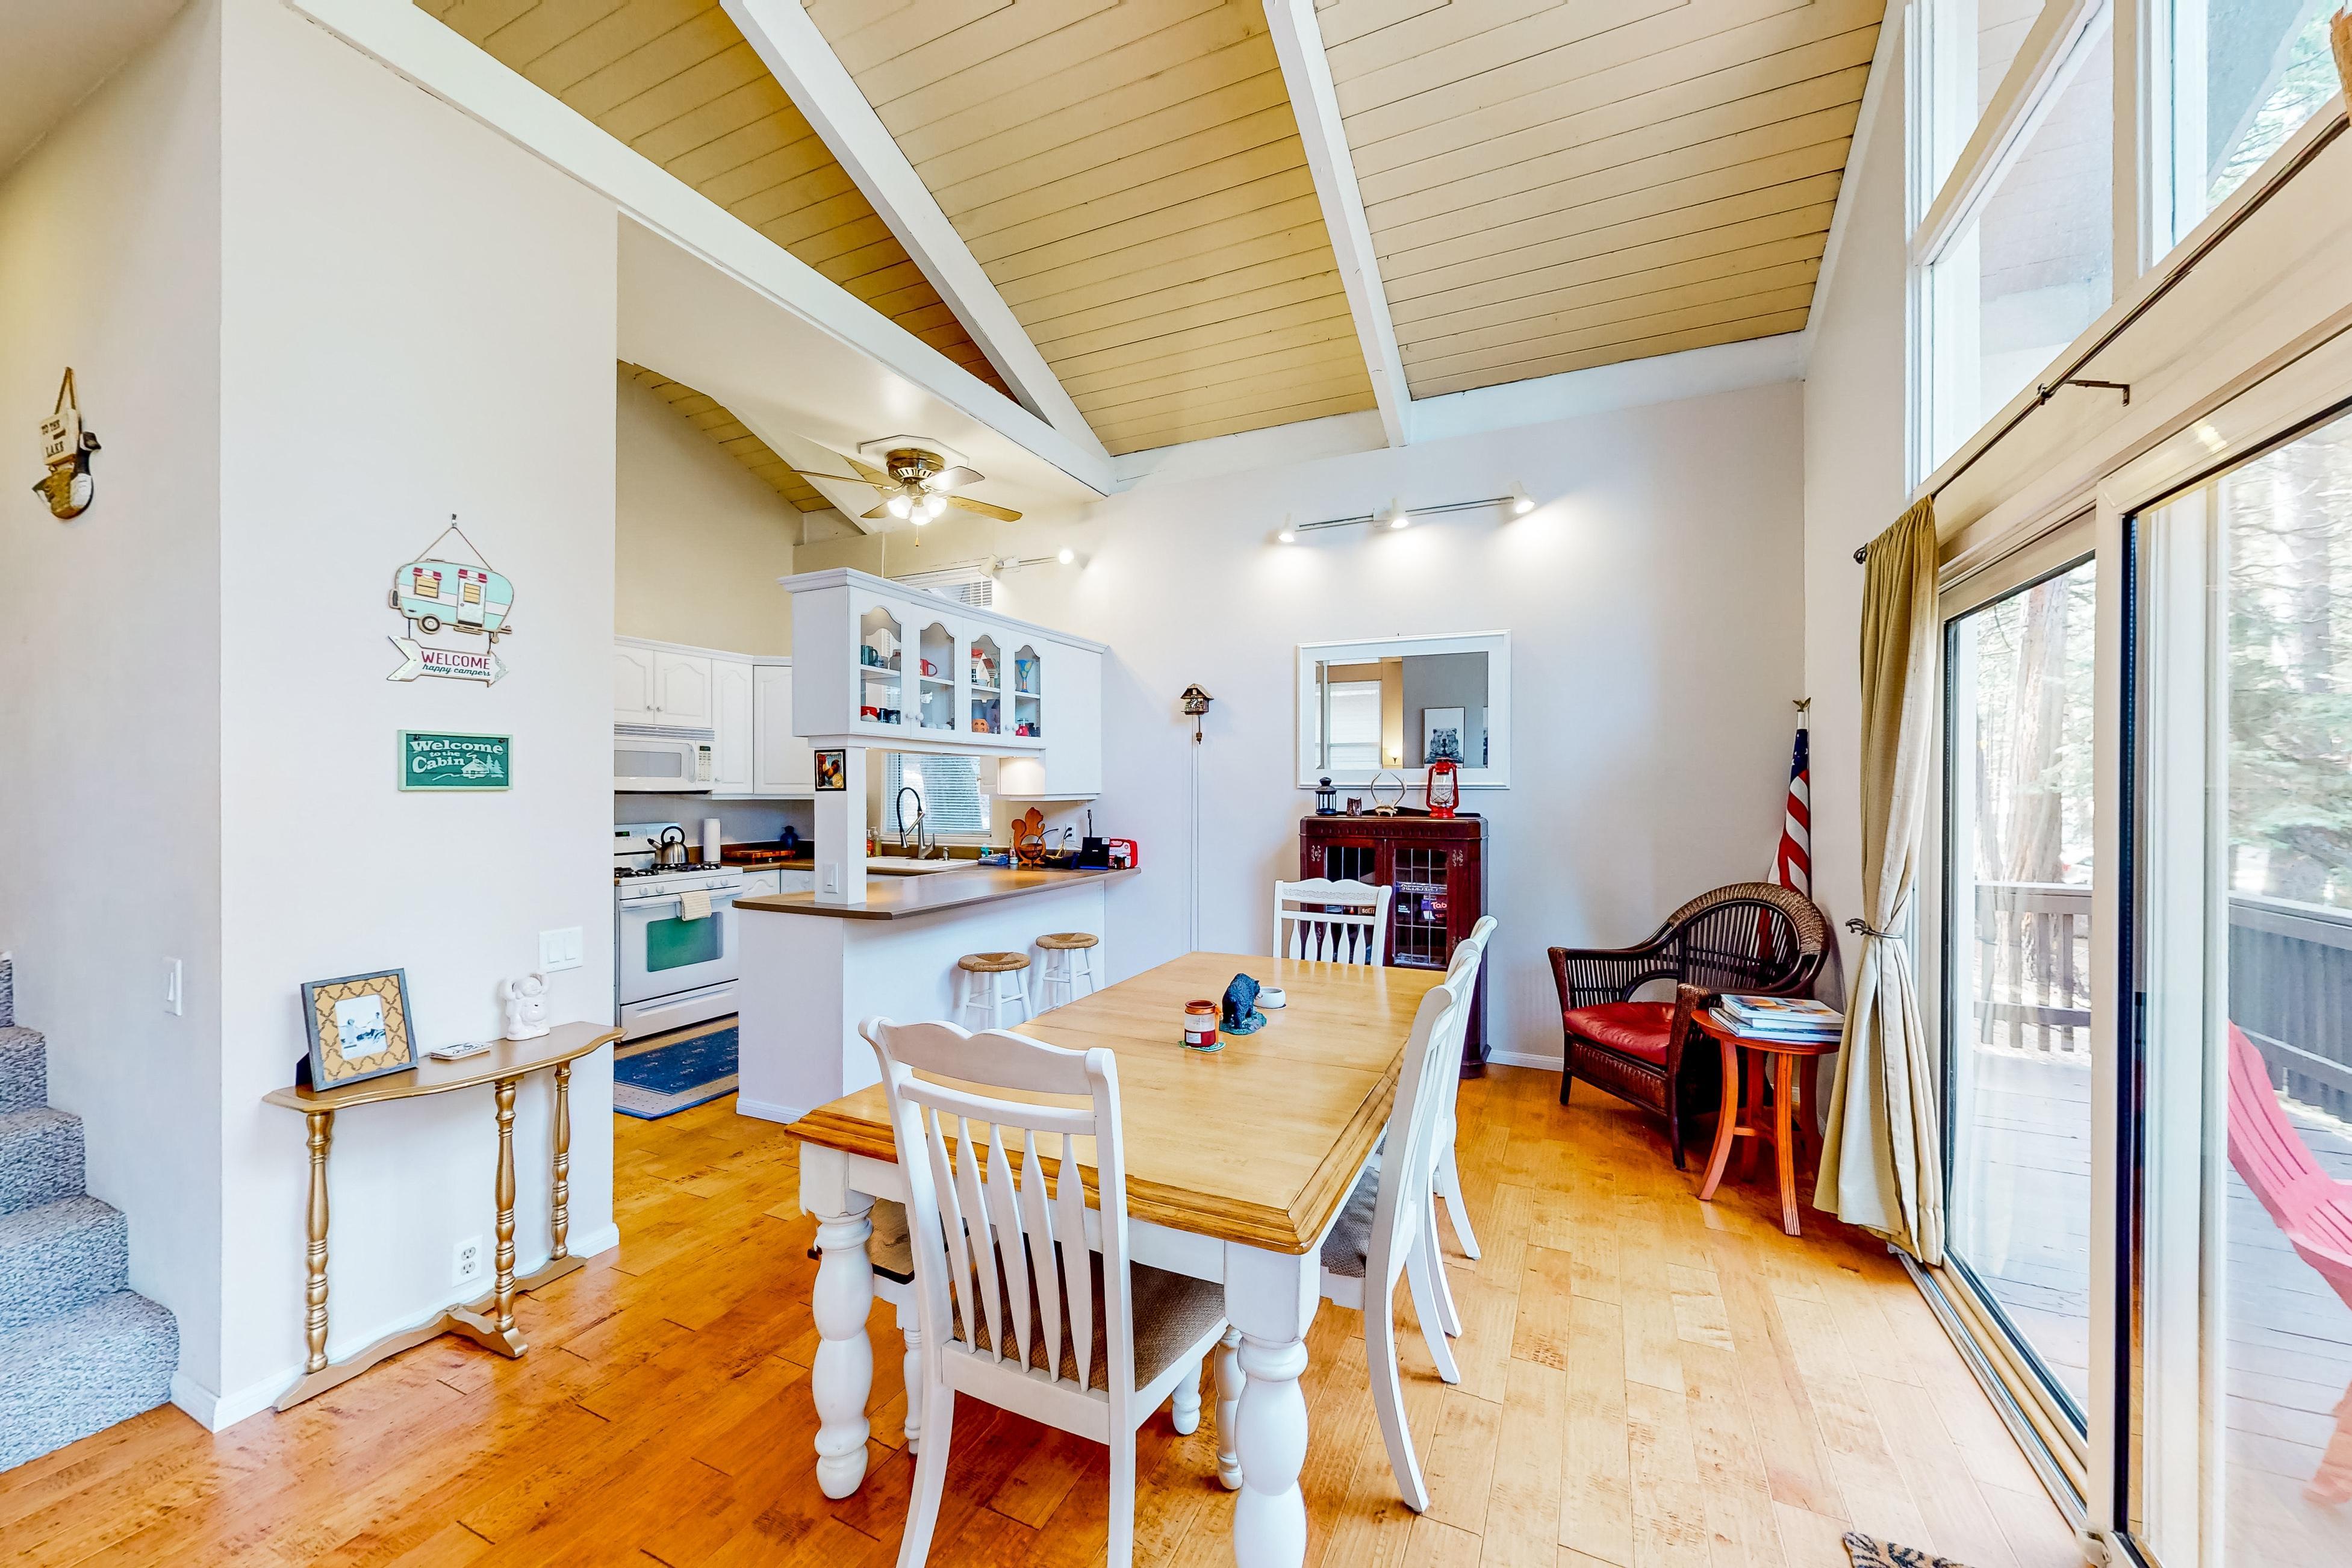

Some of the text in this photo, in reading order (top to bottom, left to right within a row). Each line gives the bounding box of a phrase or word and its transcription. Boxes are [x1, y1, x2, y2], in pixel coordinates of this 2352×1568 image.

[46, 441, 64, 458] LAKE
[421, 651, 490, 670] WELCOME
[422, 664, 452, 674] happy
[409, 739, 504, 755] Welcome
[412, 756, 465, 773] Cabin
